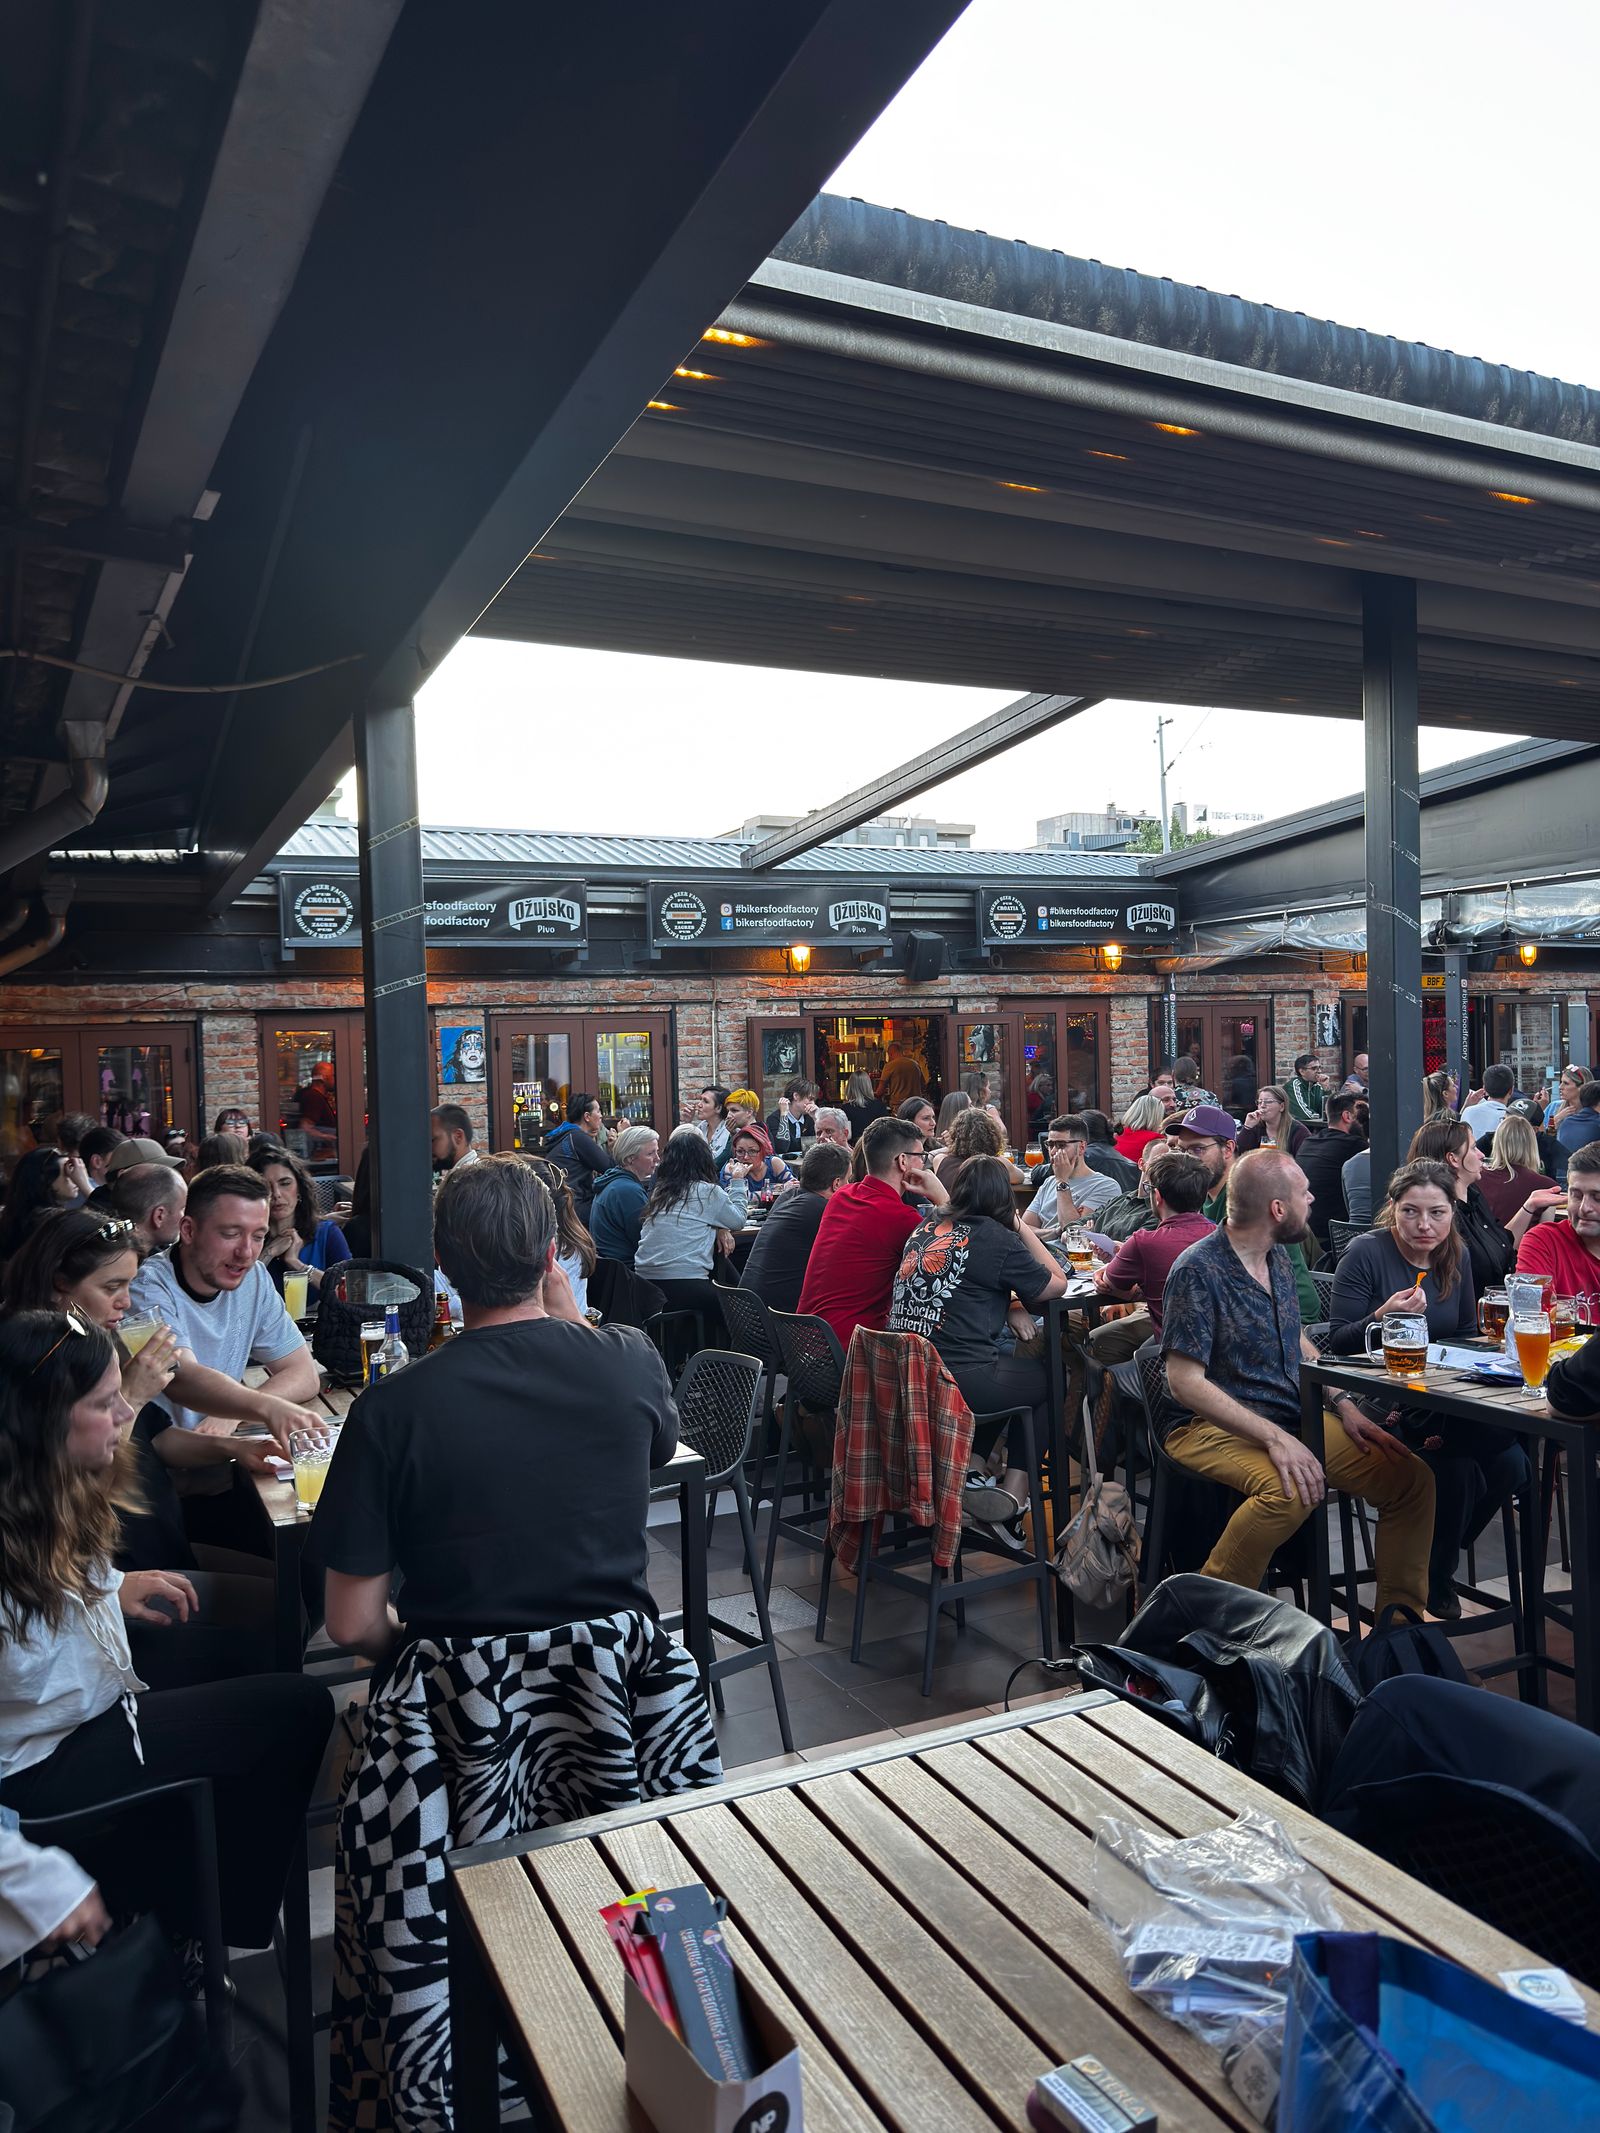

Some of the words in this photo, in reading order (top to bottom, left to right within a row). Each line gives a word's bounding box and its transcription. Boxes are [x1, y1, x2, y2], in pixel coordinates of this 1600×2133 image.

[424, 900, 497, 913] sfoodfactory
[514, 898, 575, 920] Ožujsko
[735, 904, 819, 916] #bikersfoodfactory
[834, 901, 882, 923] Ožujsko
[1049, 906, 1120, 917] #bikersfoodfactory
[1130, 904, 1172, 924] Ožujsko
[424, 915, 490, 928] foodfactory
[736, 916, 815, 929] bikersfoodfactory
[1050, 918, 1115, 930] bikersfoodfactory
[537, 924, 556, 934] Pivo
[851, 925, 866, 934] Pivo
[890, 1314, 934, 1336] Butterfly
